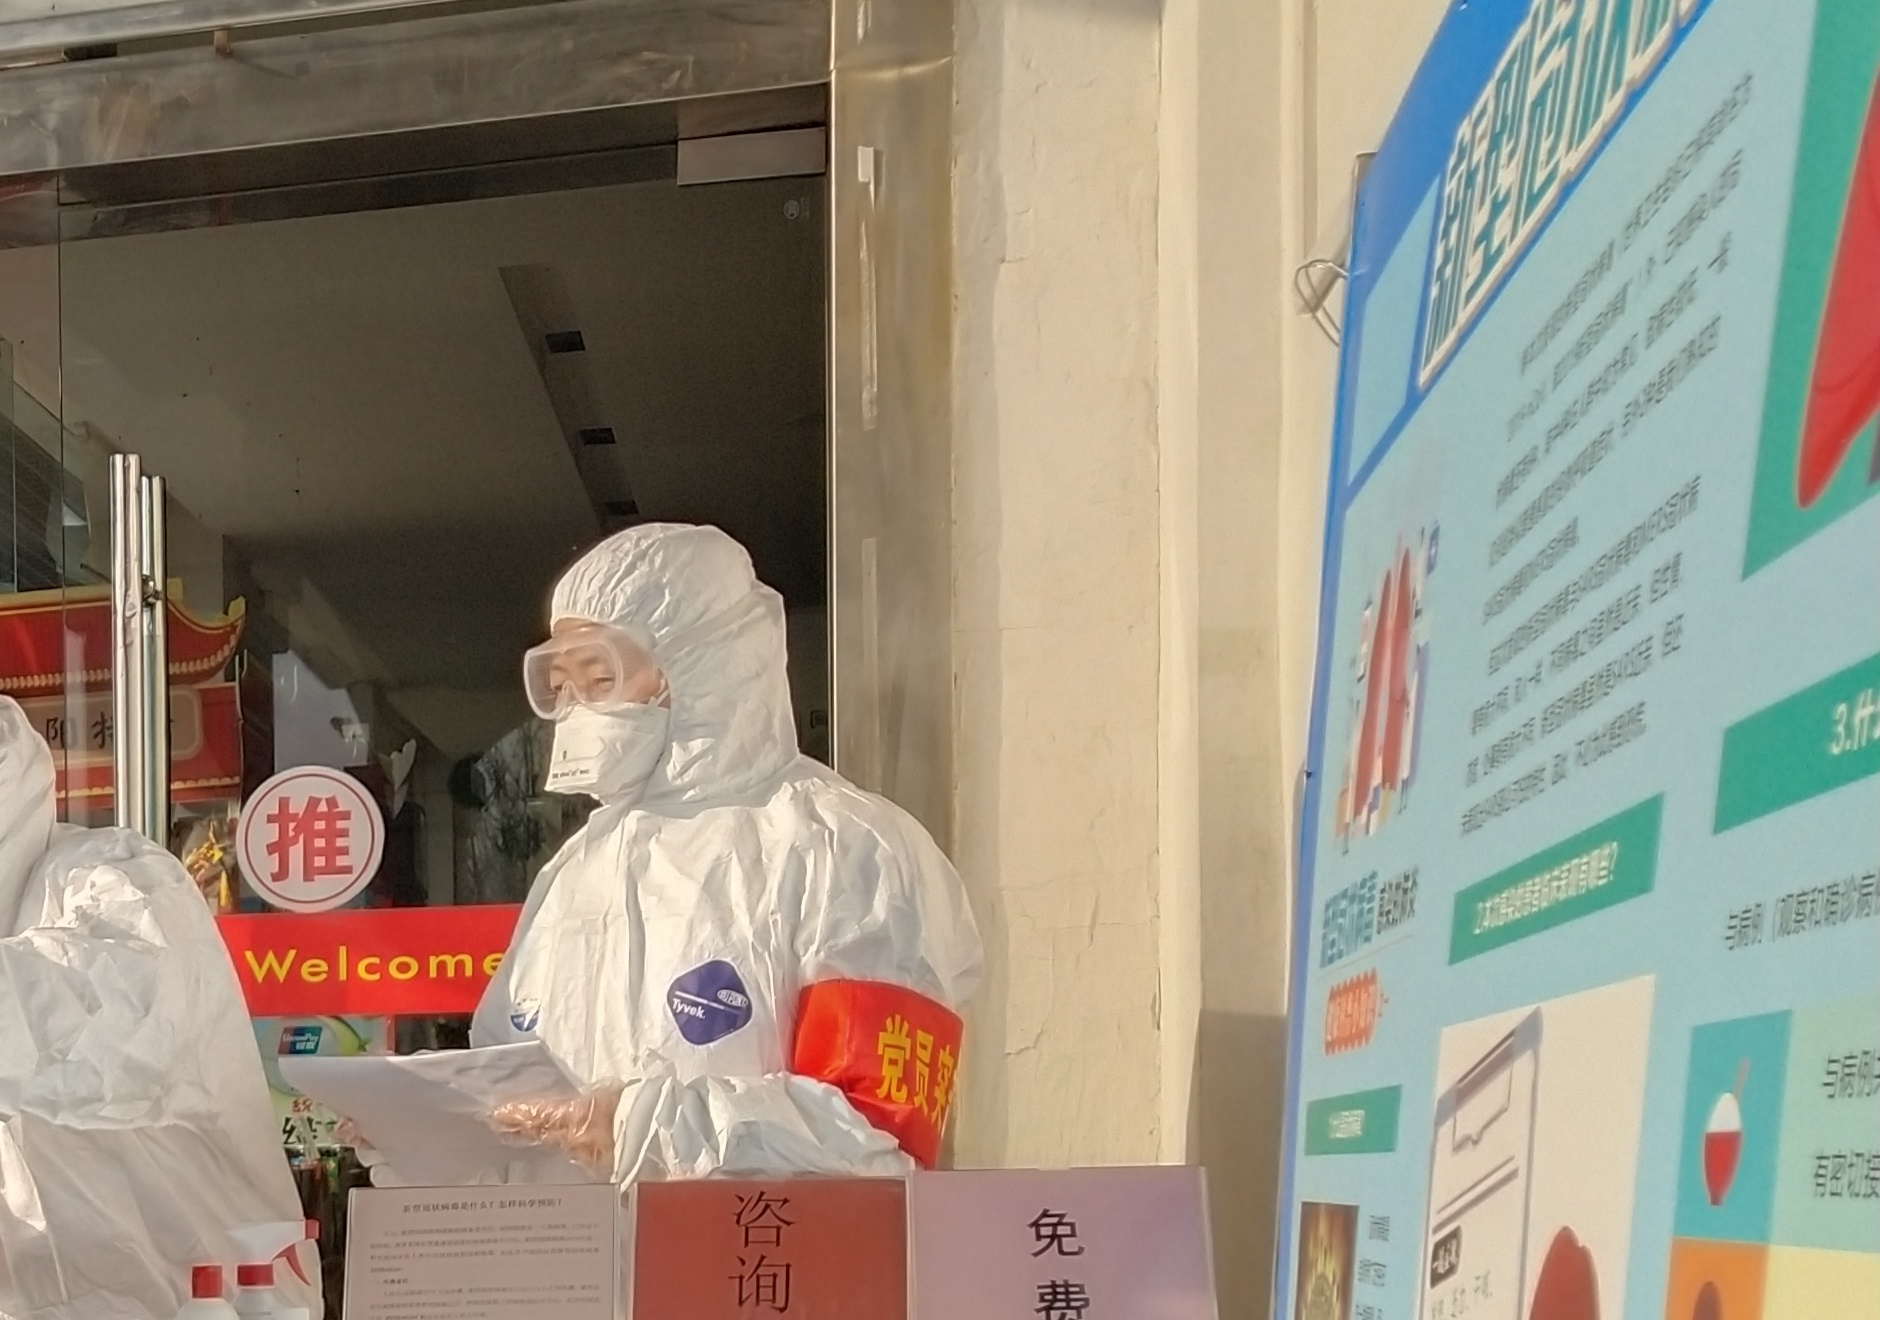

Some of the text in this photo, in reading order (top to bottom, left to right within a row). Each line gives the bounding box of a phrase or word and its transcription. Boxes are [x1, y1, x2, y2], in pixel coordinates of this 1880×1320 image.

[1420, 0, 1706, 387] 新型冠状
[266, 795, 354, 883] 推
[1724, 866, 1880, 951] 与病例（观察和确诊病
[244, 946, 507, 986] Welcome
[876, 1013, 956, 1133] 党员突
